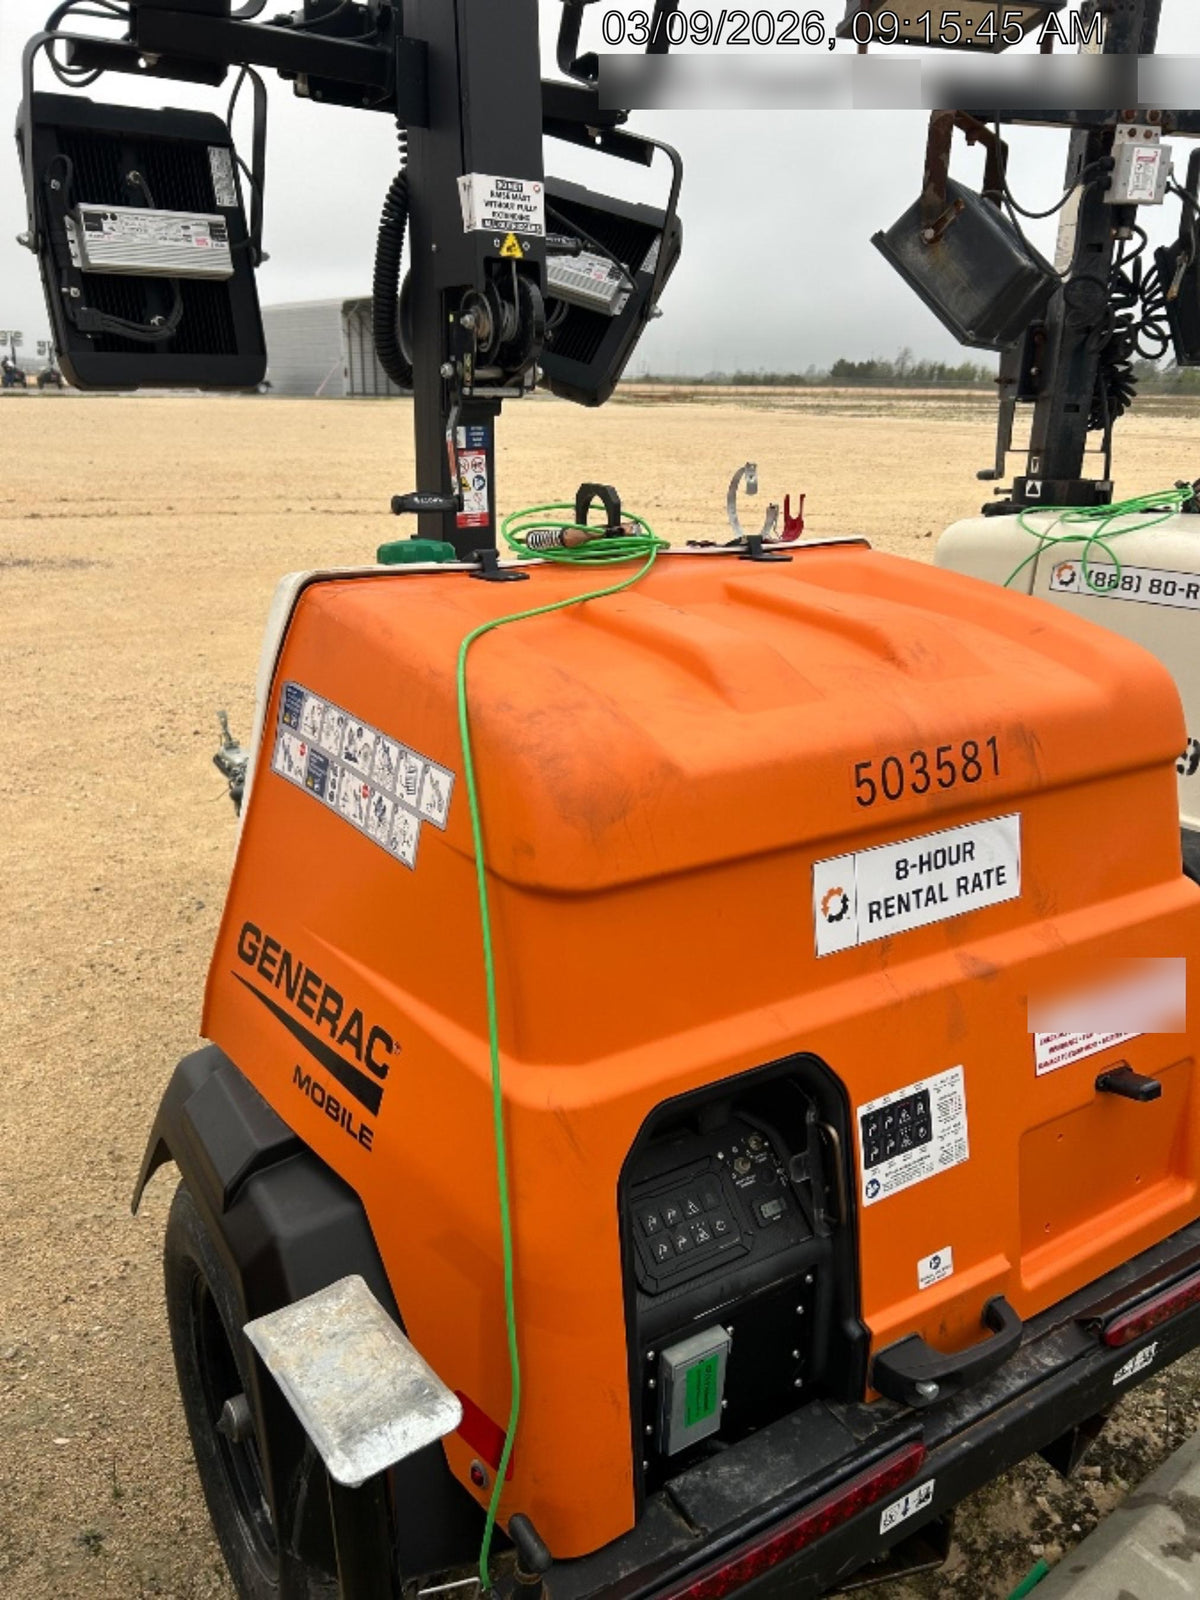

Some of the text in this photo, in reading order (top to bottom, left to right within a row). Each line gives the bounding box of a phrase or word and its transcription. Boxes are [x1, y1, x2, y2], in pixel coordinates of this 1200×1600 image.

[854, 735, 1000, 807] 503581
[868, 865, 1007, 924] RENTAL RATE
[895, 840, 975, 880] 8-HOUR
[237, 920, 395, 1081] GENERAC
[292, 1064, 374, 1152] MOBILE
